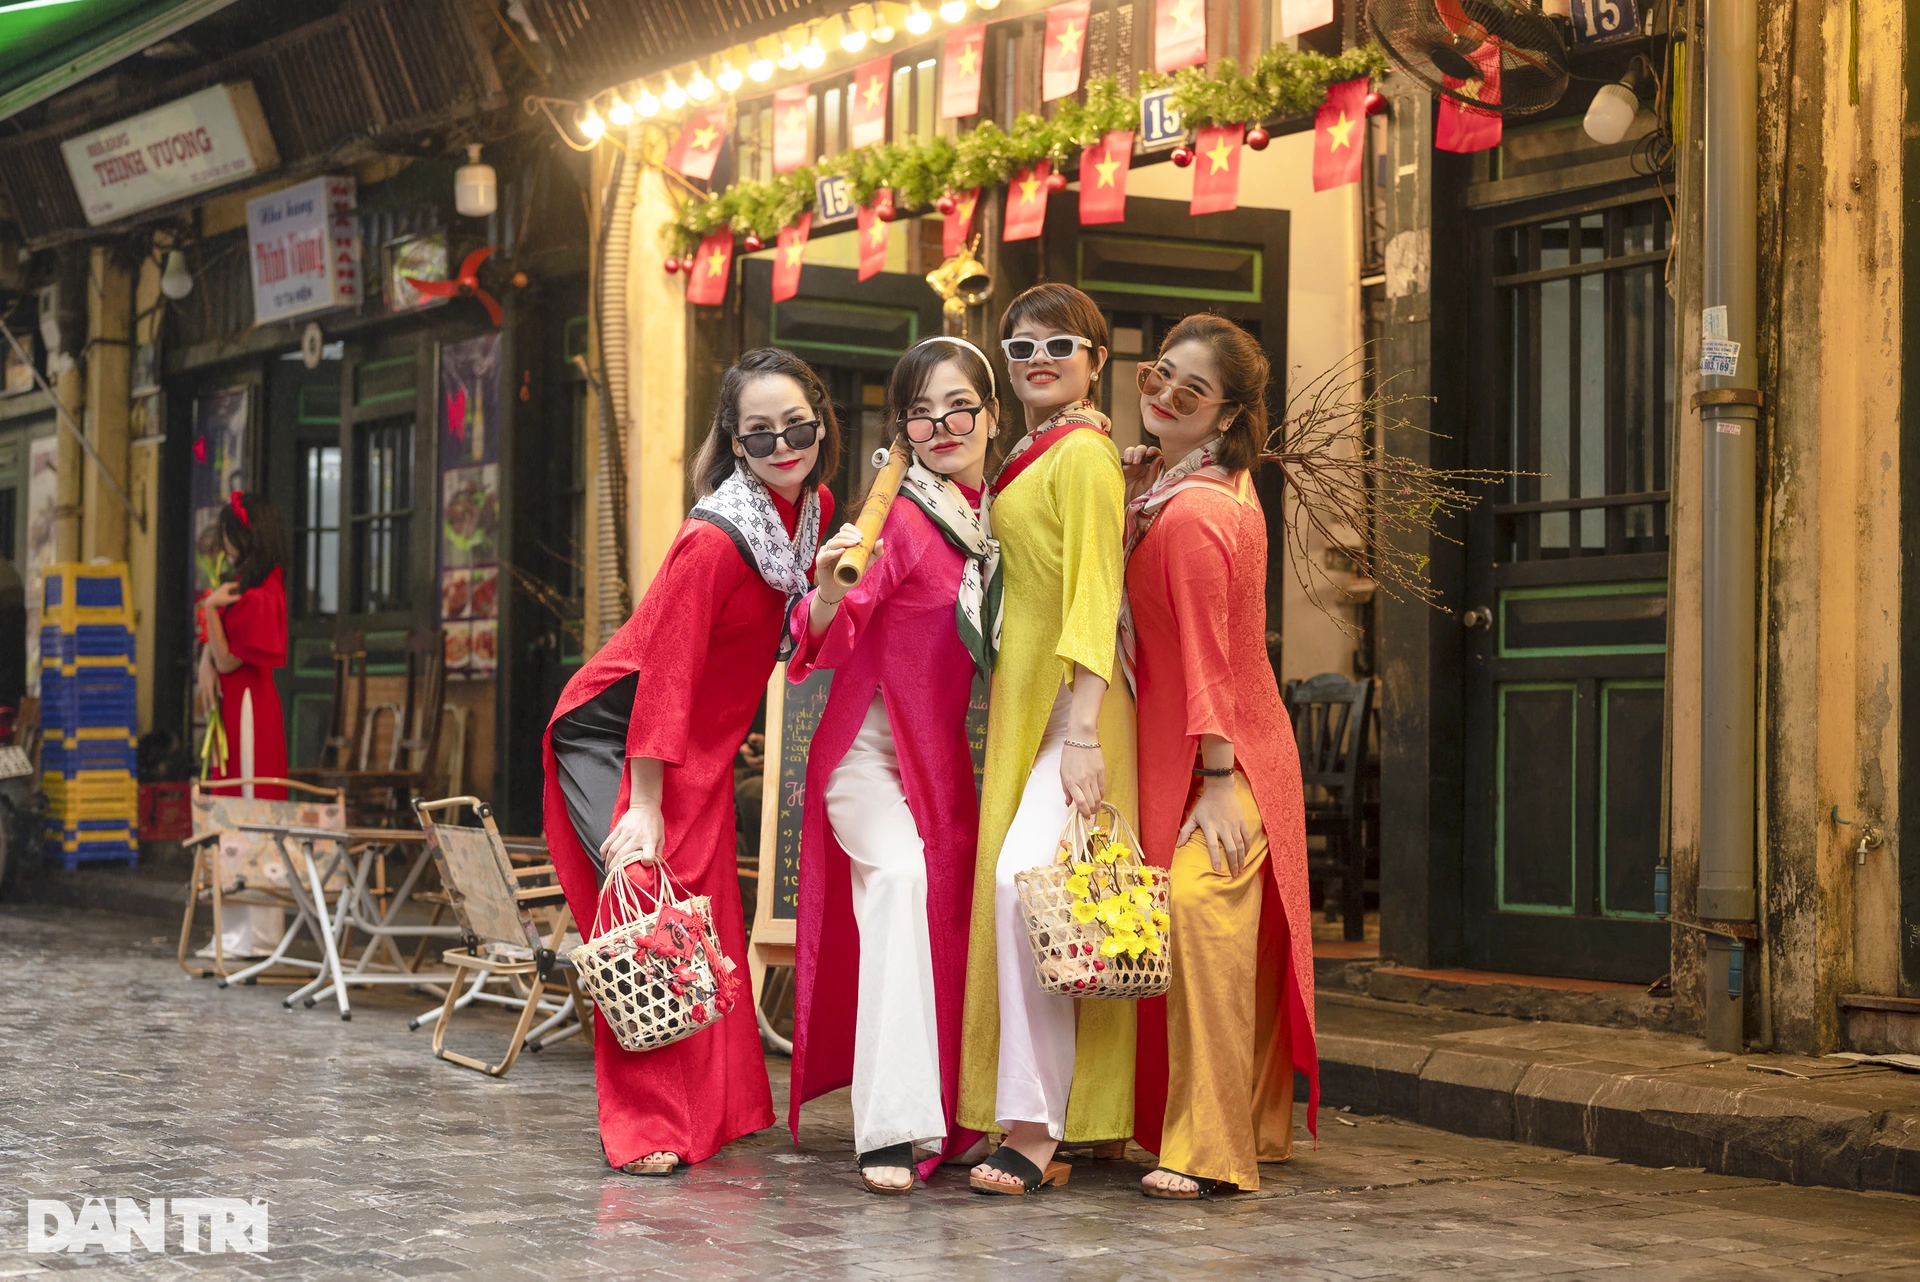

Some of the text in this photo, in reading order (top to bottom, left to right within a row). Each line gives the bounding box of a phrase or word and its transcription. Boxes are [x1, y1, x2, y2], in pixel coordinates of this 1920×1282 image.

[1582, 0, 1620, 37] 15
[1150, 97, 1180, 139] 15
[823, 179, 849, 216] 15
